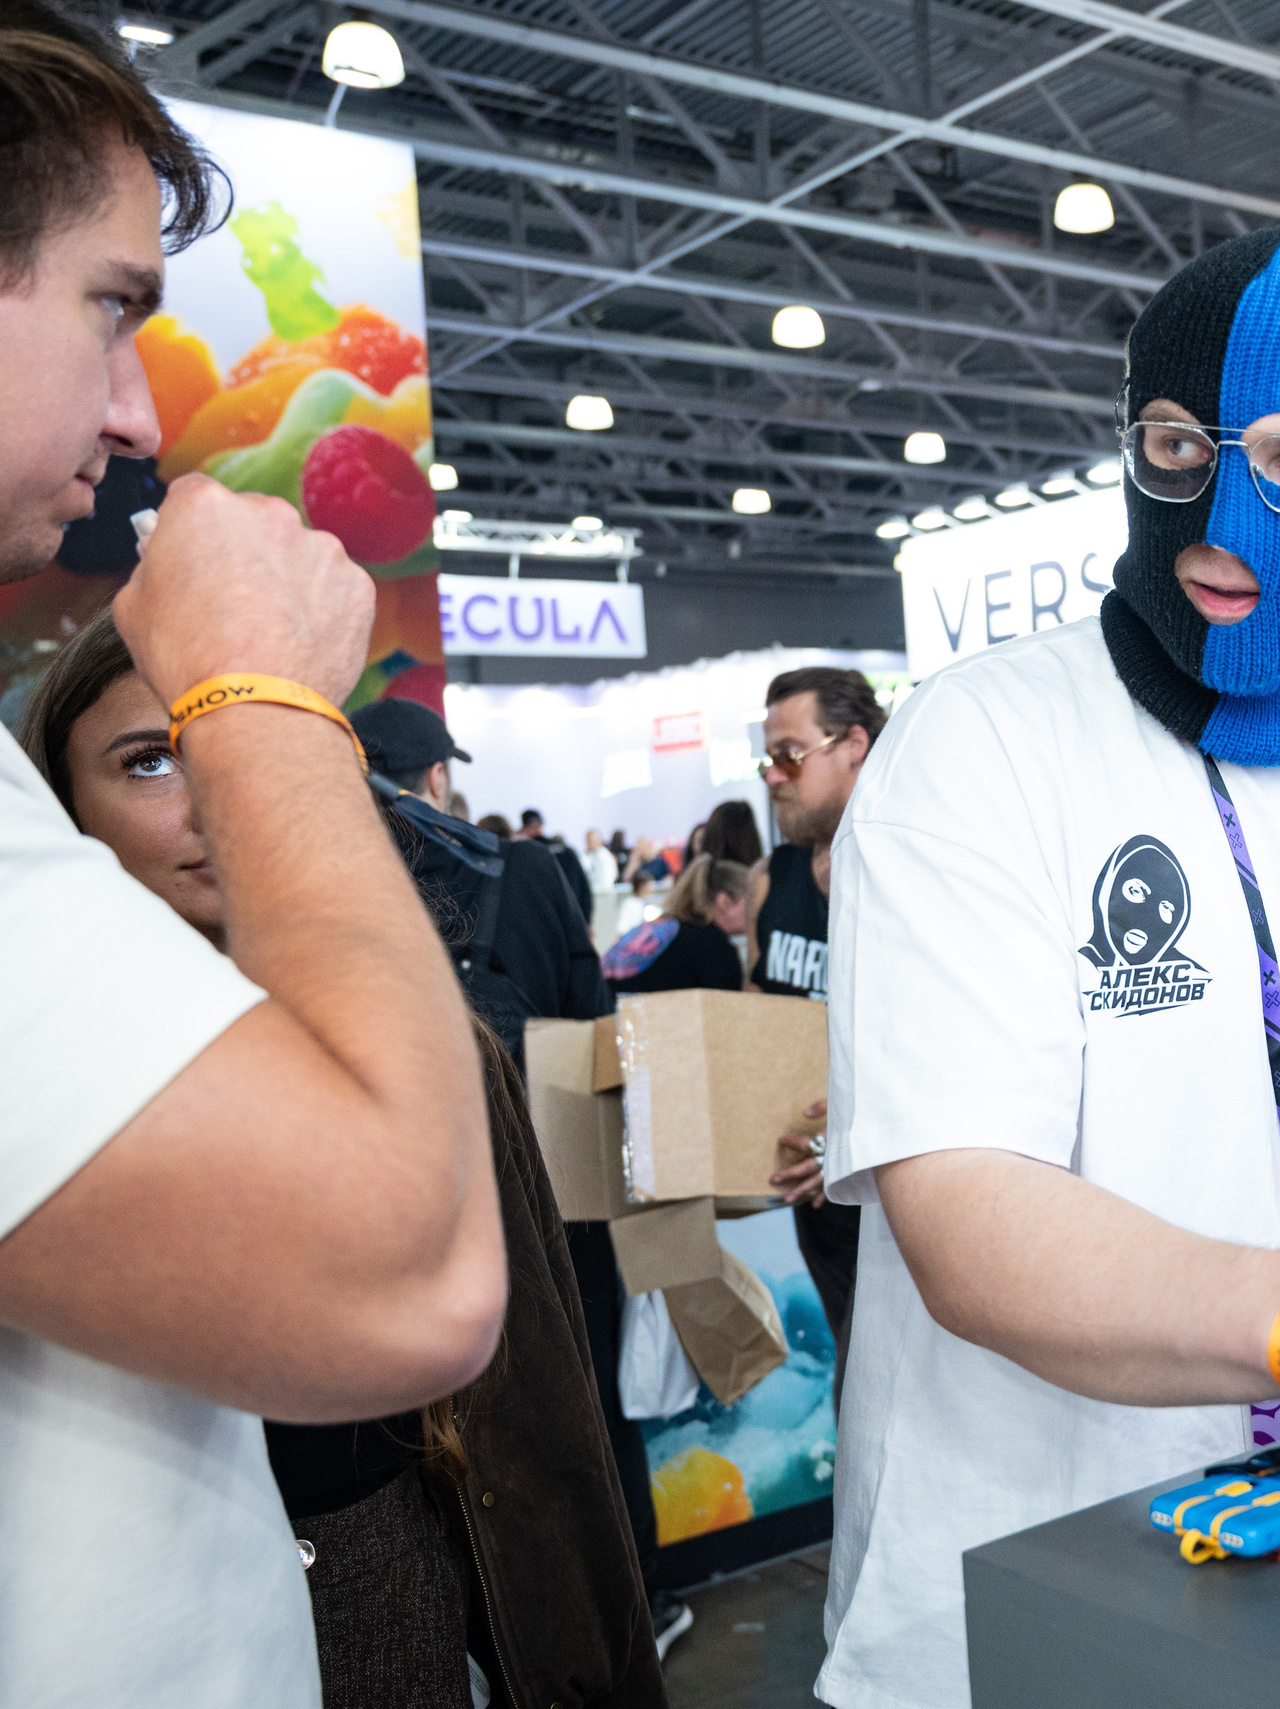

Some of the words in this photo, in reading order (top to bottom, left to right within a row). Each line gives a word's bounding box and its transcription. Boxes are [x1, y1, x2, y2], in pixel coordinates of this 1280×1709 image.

[767, 930, 828, 992] NAR
[1100, 964, 1192, 989] АЛЕКС
[1090, 982, 1206, 1012] СКИДОНОВ
